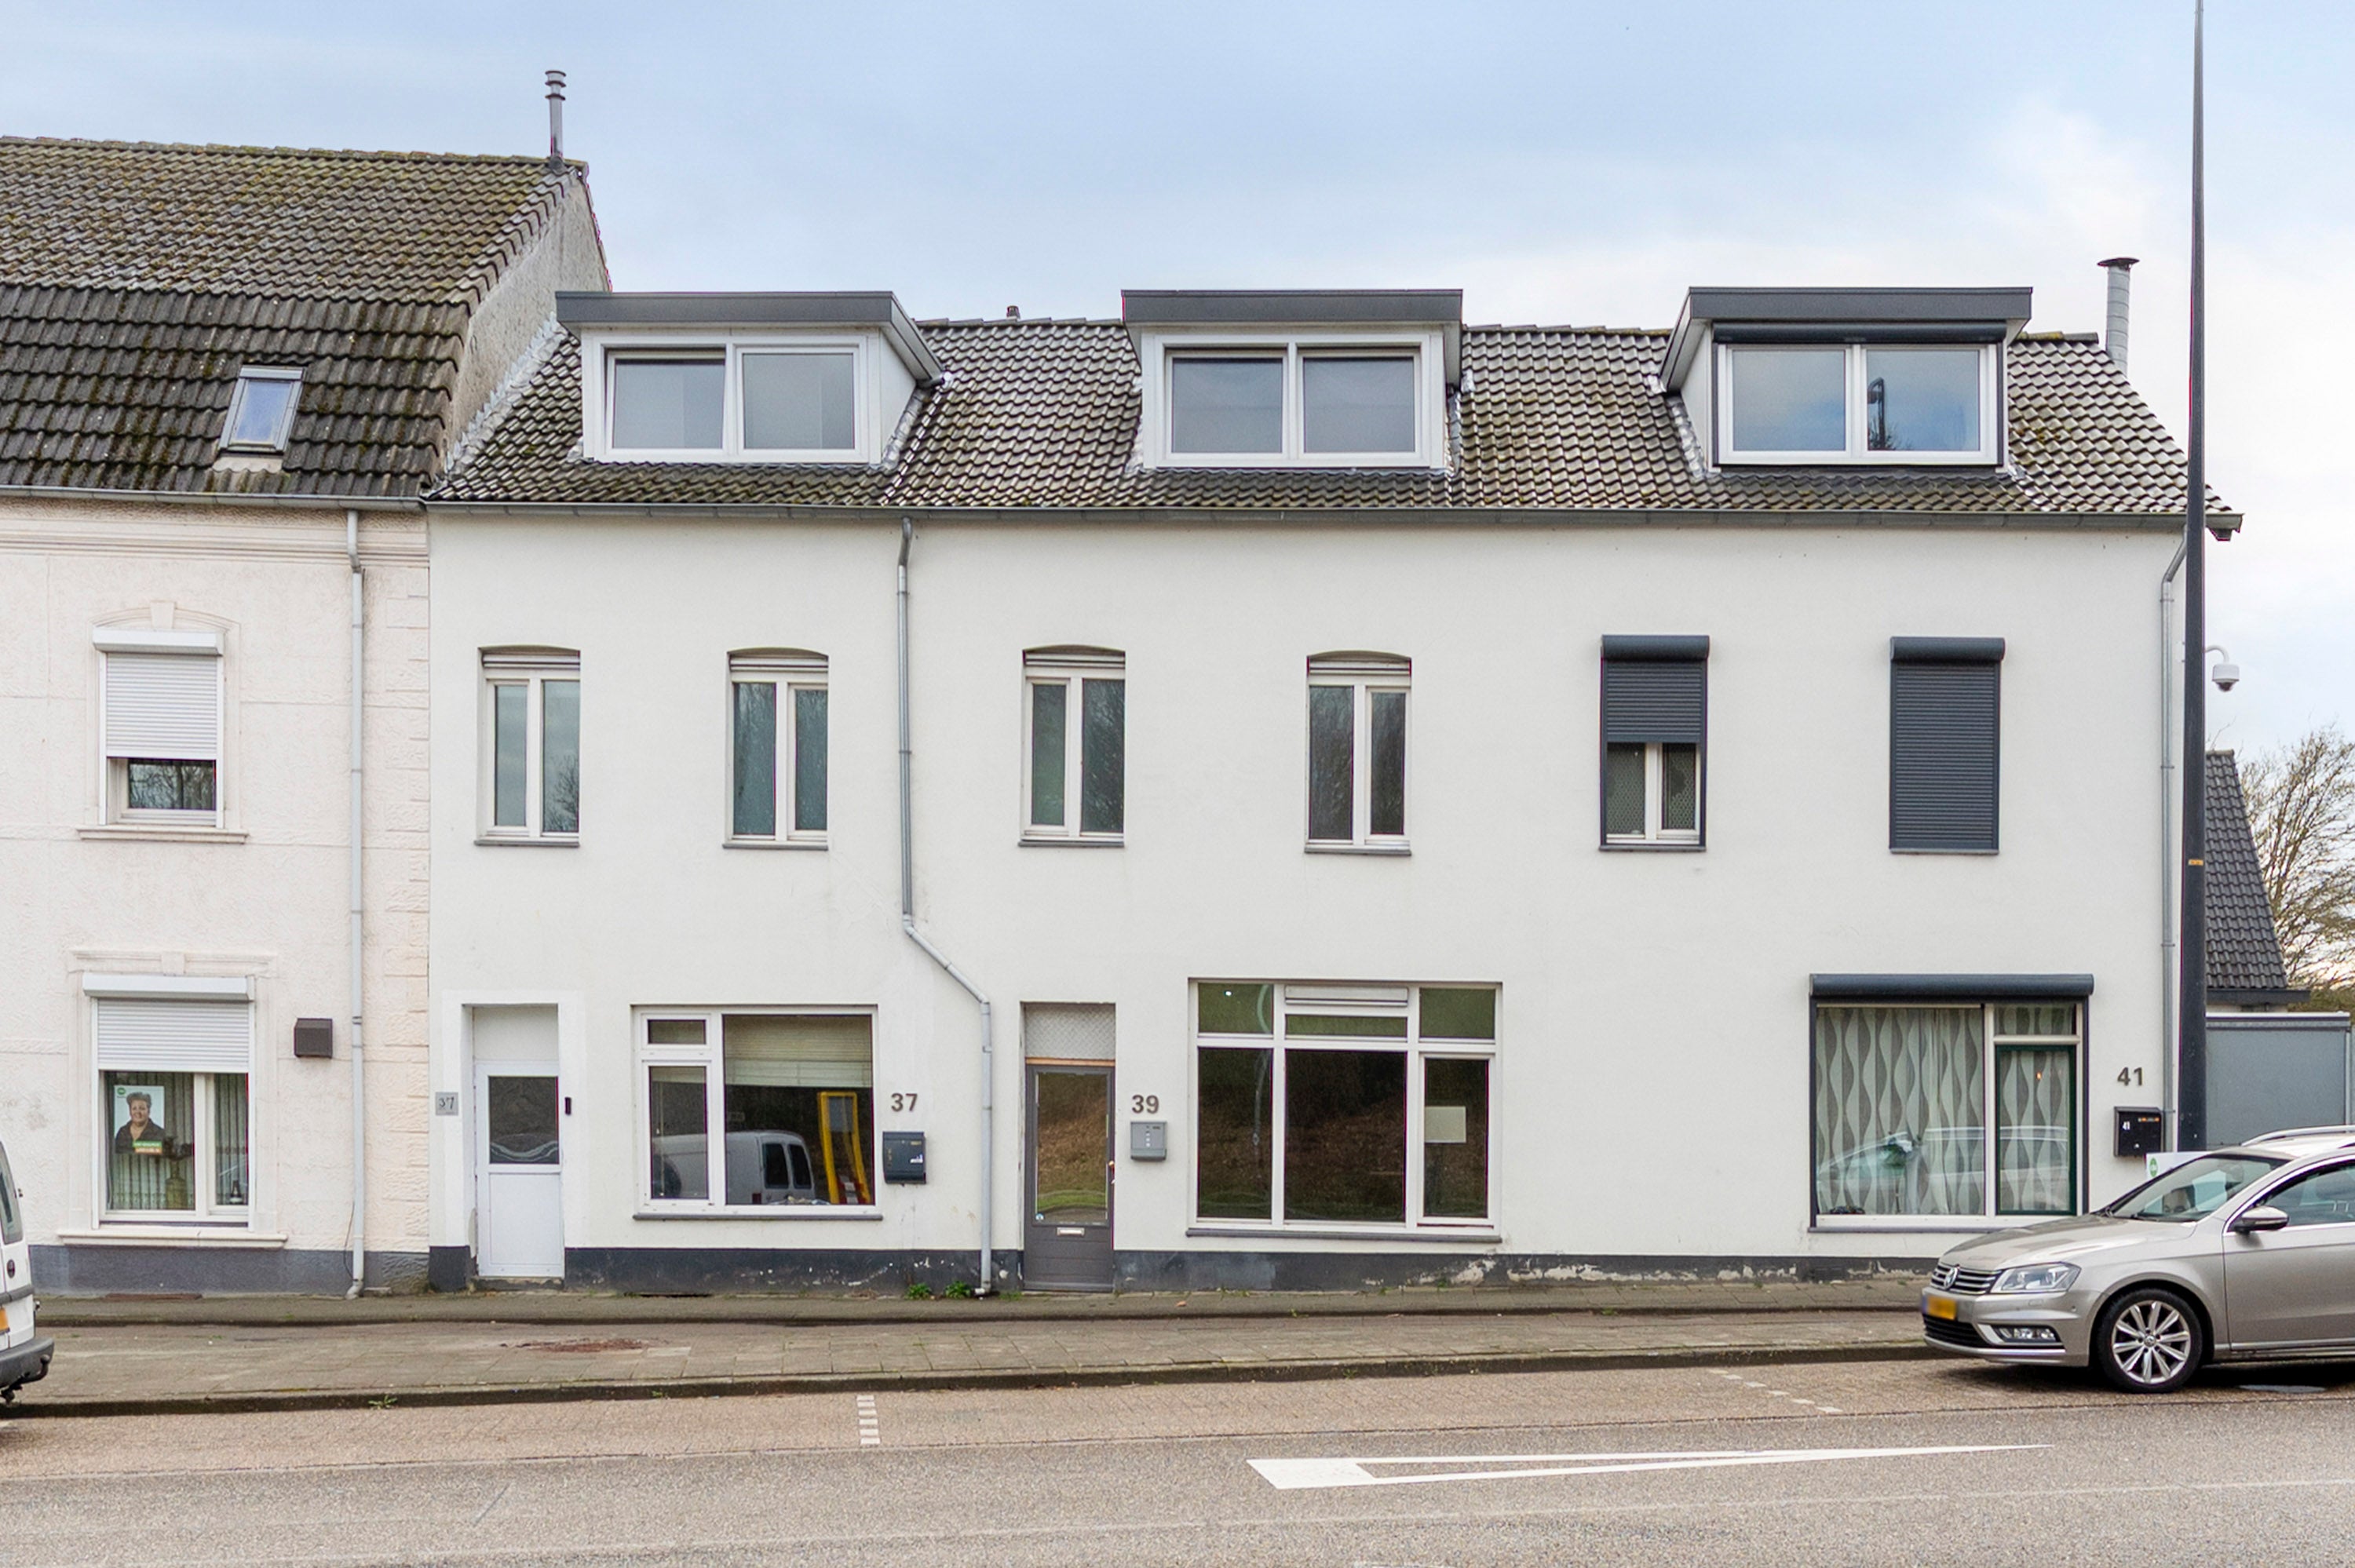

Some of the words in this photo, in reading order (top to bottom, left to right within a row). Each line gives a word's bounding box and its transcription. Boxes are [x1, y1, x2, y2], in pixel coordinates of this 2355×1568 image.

[2117, 1067, 2143, 1086] 41
[439, 1096, 455, 1110] 37
[891, 1092, 918, 1112] 37
[1132, 1095, 1159, 1114] 39
[2123, 1121, 2130, 1130] 41
